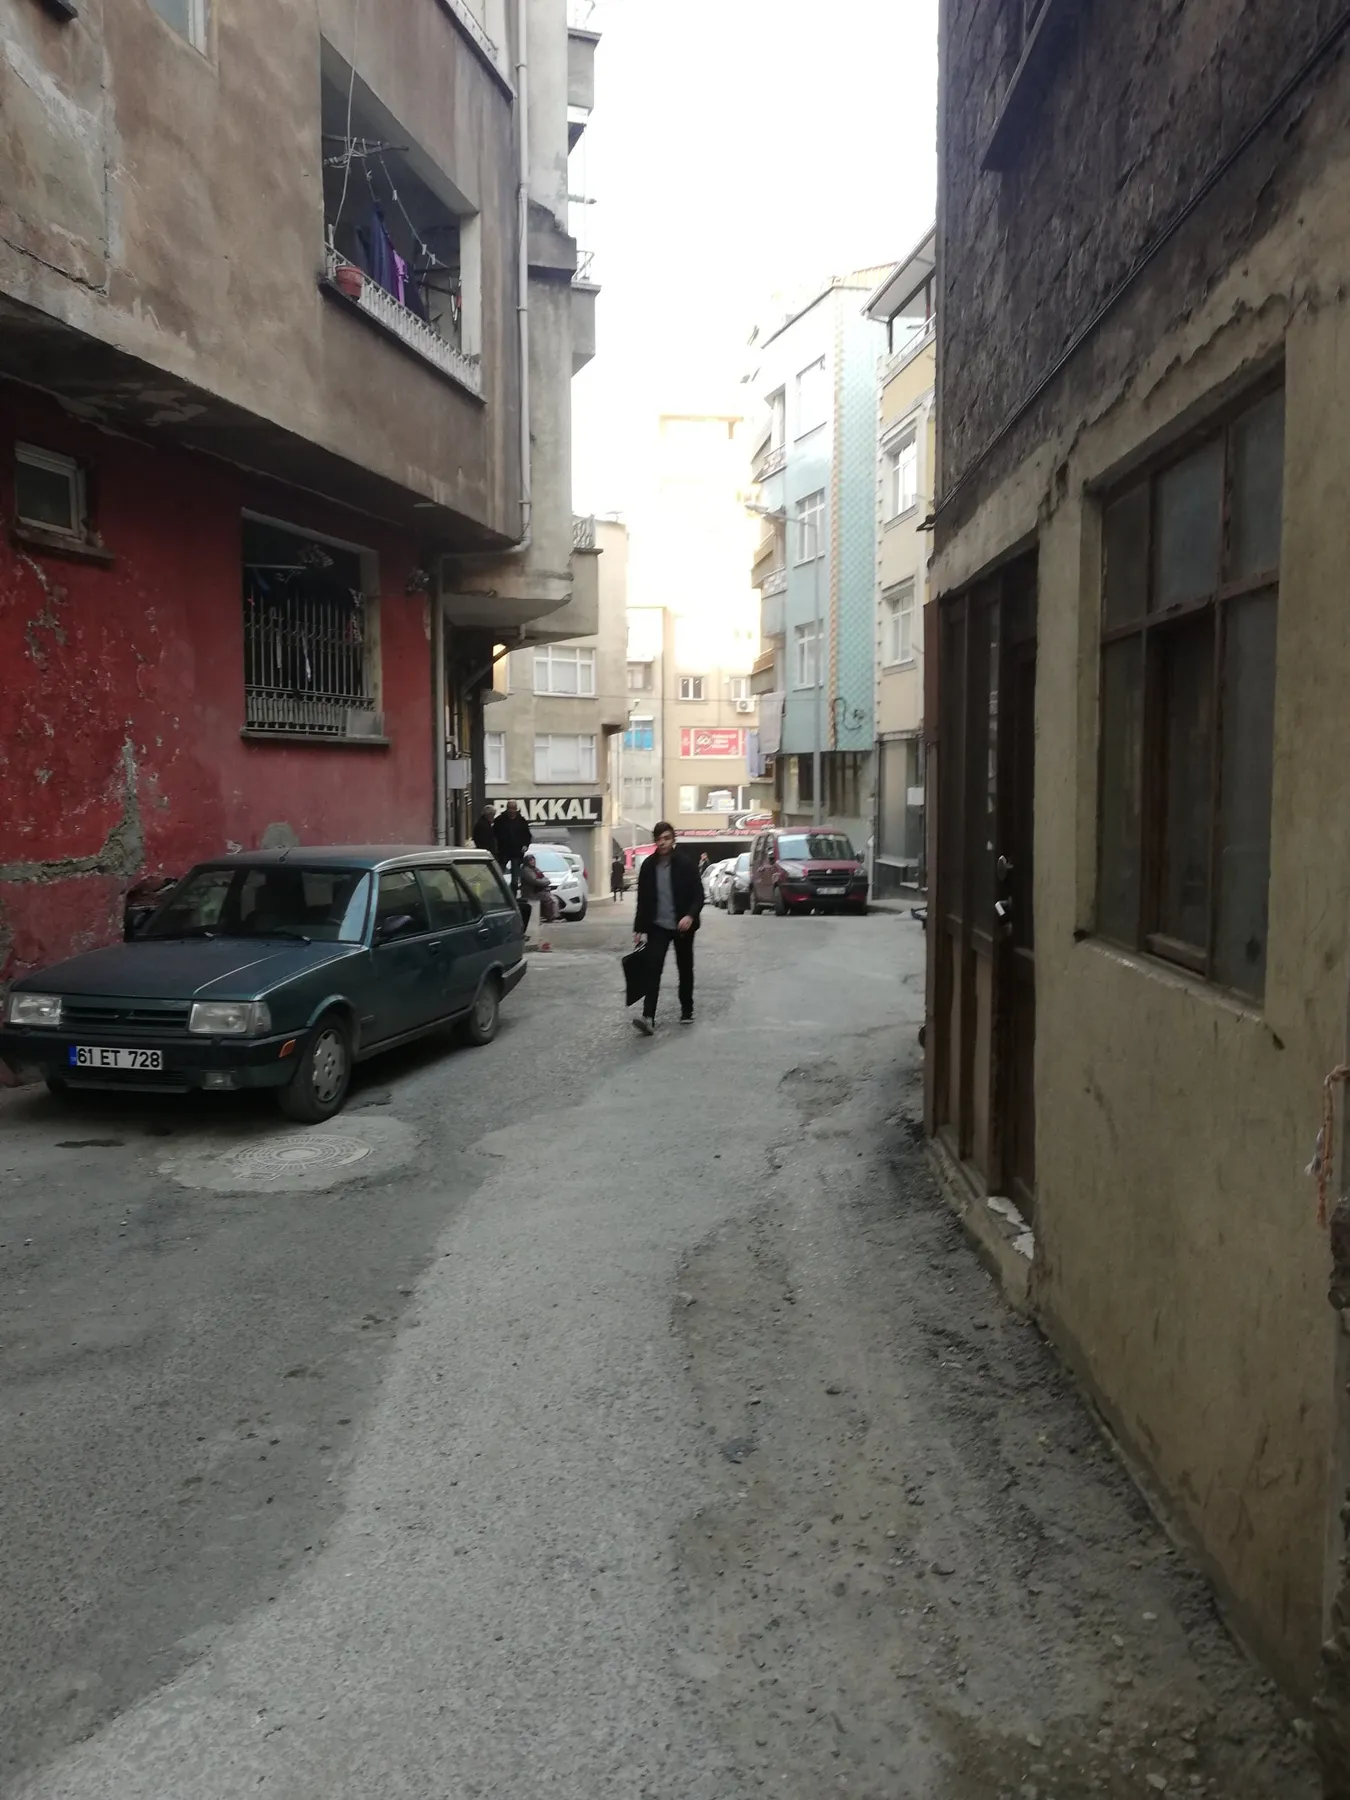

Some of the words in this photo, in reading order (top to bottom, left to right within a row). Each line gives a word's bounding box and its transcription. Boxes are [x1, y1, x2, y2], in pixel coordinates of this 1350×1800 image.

[77, 1048, 93, 1065] 61
[100, 1049, 121, 1066] ET
[128, 1050, 160, 1068] 728
